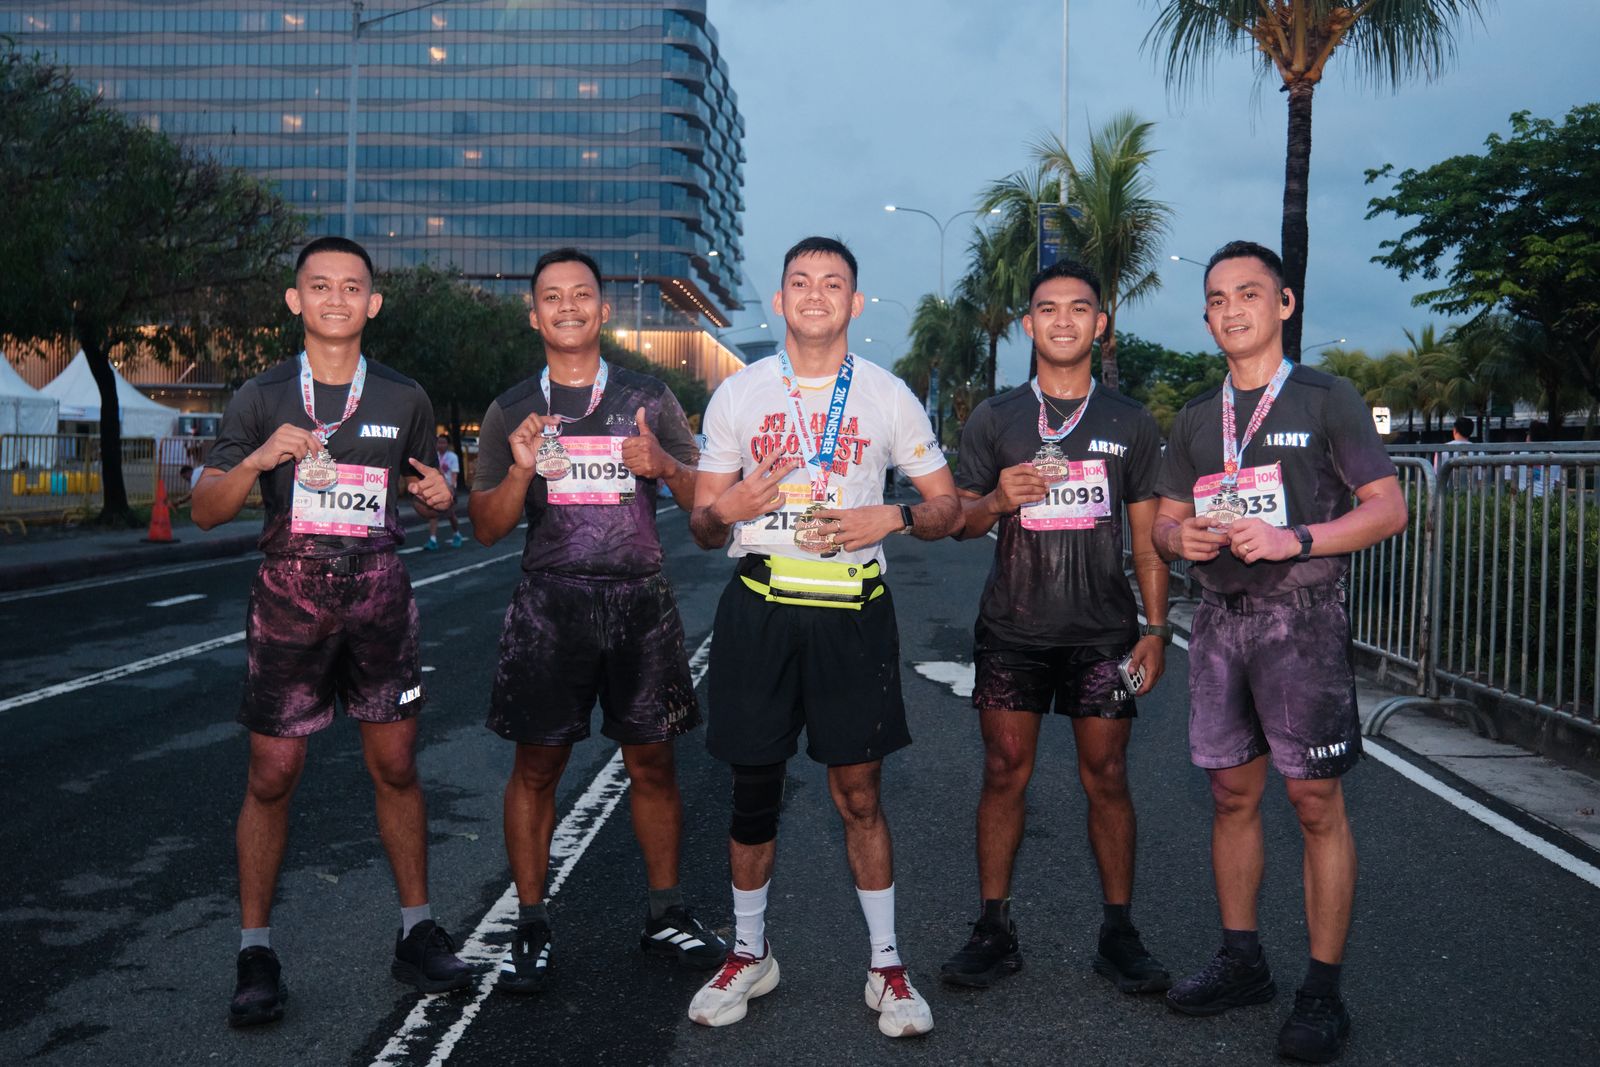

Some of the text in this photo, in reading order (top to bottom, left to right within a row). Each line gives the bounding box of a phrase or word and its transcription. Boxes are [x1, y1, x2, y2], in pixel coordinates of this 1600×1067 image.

[759, 412, 786, 433] JCI
[821, 386, 847, 455] 21K FINISHER
[359, 424, 400, 439] ARMY
[1262, 433, 1310, 447] ARMY
[1087, 439, 1128, 458] ARMY
[366, 472, 383, 484] 10K
[571, 462, 630, 480] 11095
[1084, 467, 1103, 476] 10K
[1255, 471, 1278, 484] 10K
[318, 490, 380, 513] 11024
[1045, 486, 1104, 506] 11098
[1306, 741, 1350, 759] ARMY
